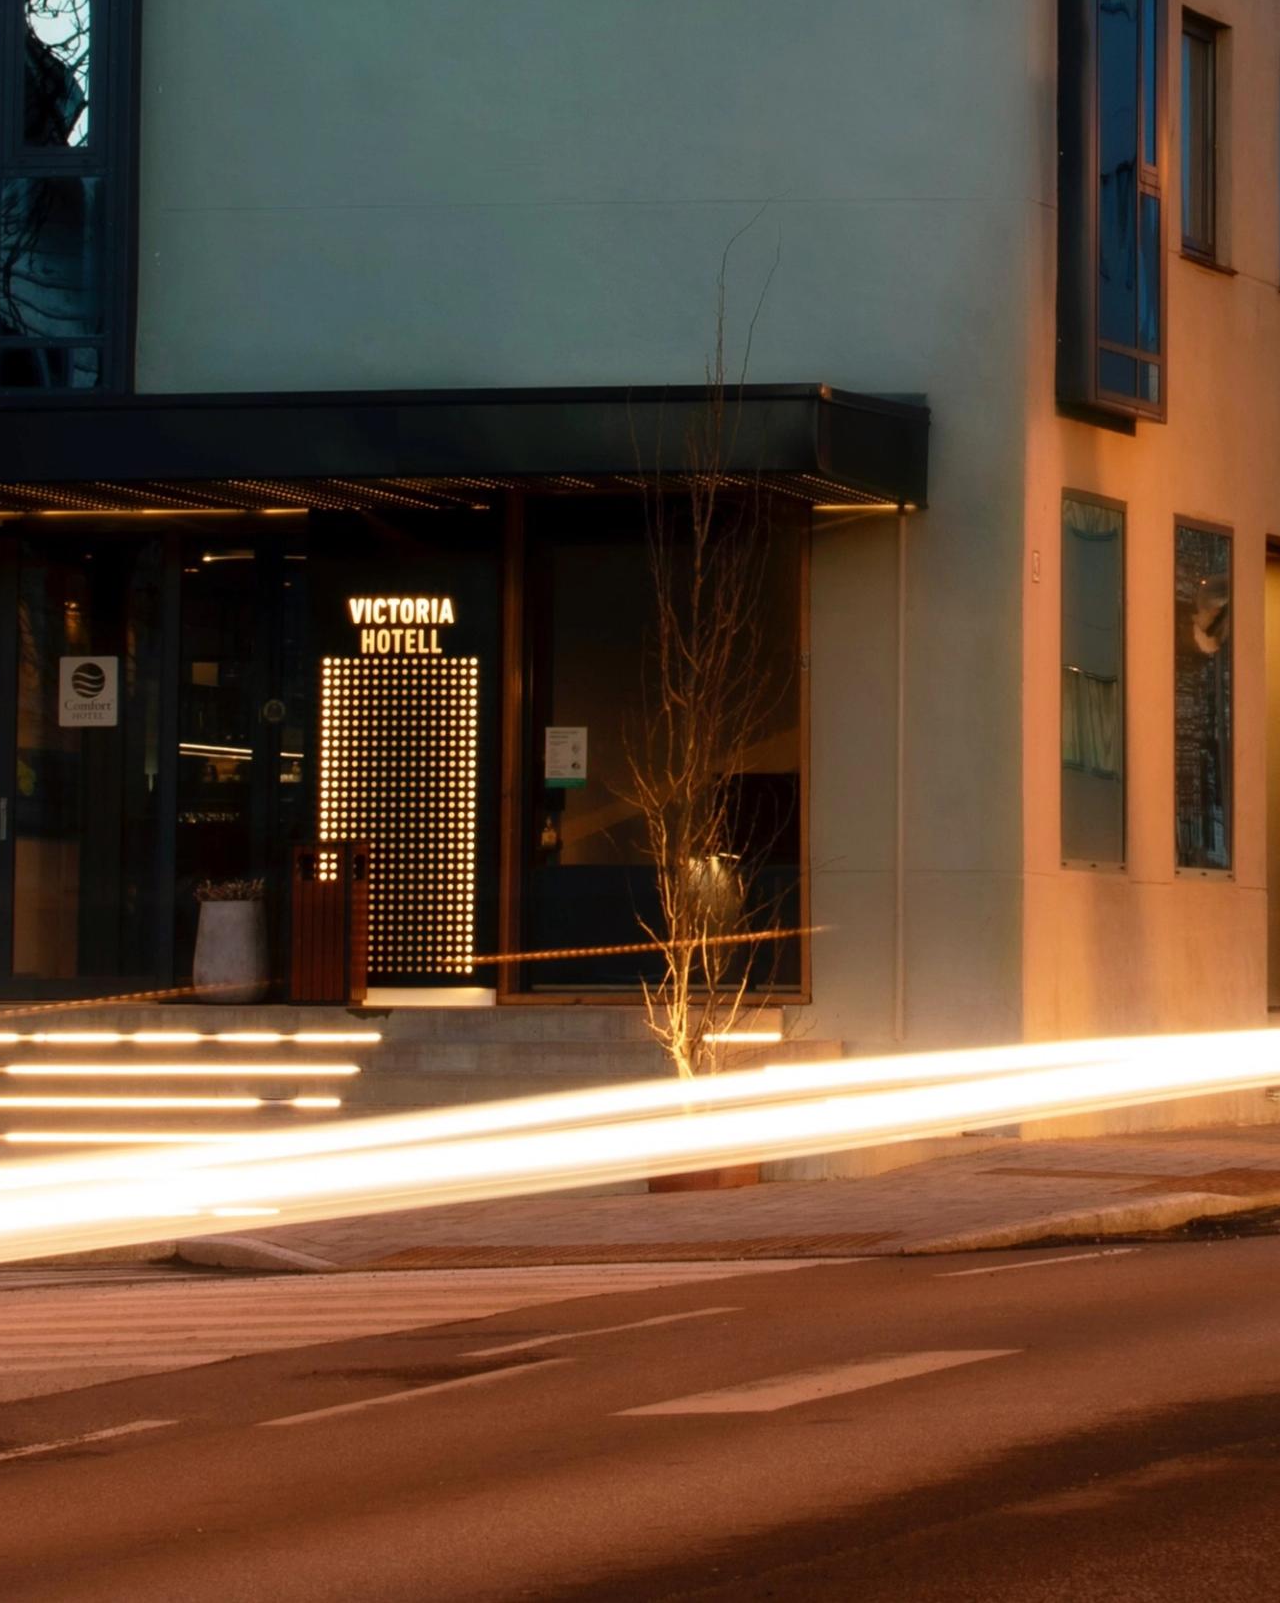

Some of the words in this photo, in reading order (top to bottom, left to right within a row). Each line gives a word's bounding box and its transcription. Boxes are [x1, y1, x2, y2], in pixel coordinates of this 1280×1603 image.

[348, 597, 455, 624] VICTORIA
[360, 628, 442, 654] HOTELL
[64, 699, 112, 711] Comfort
